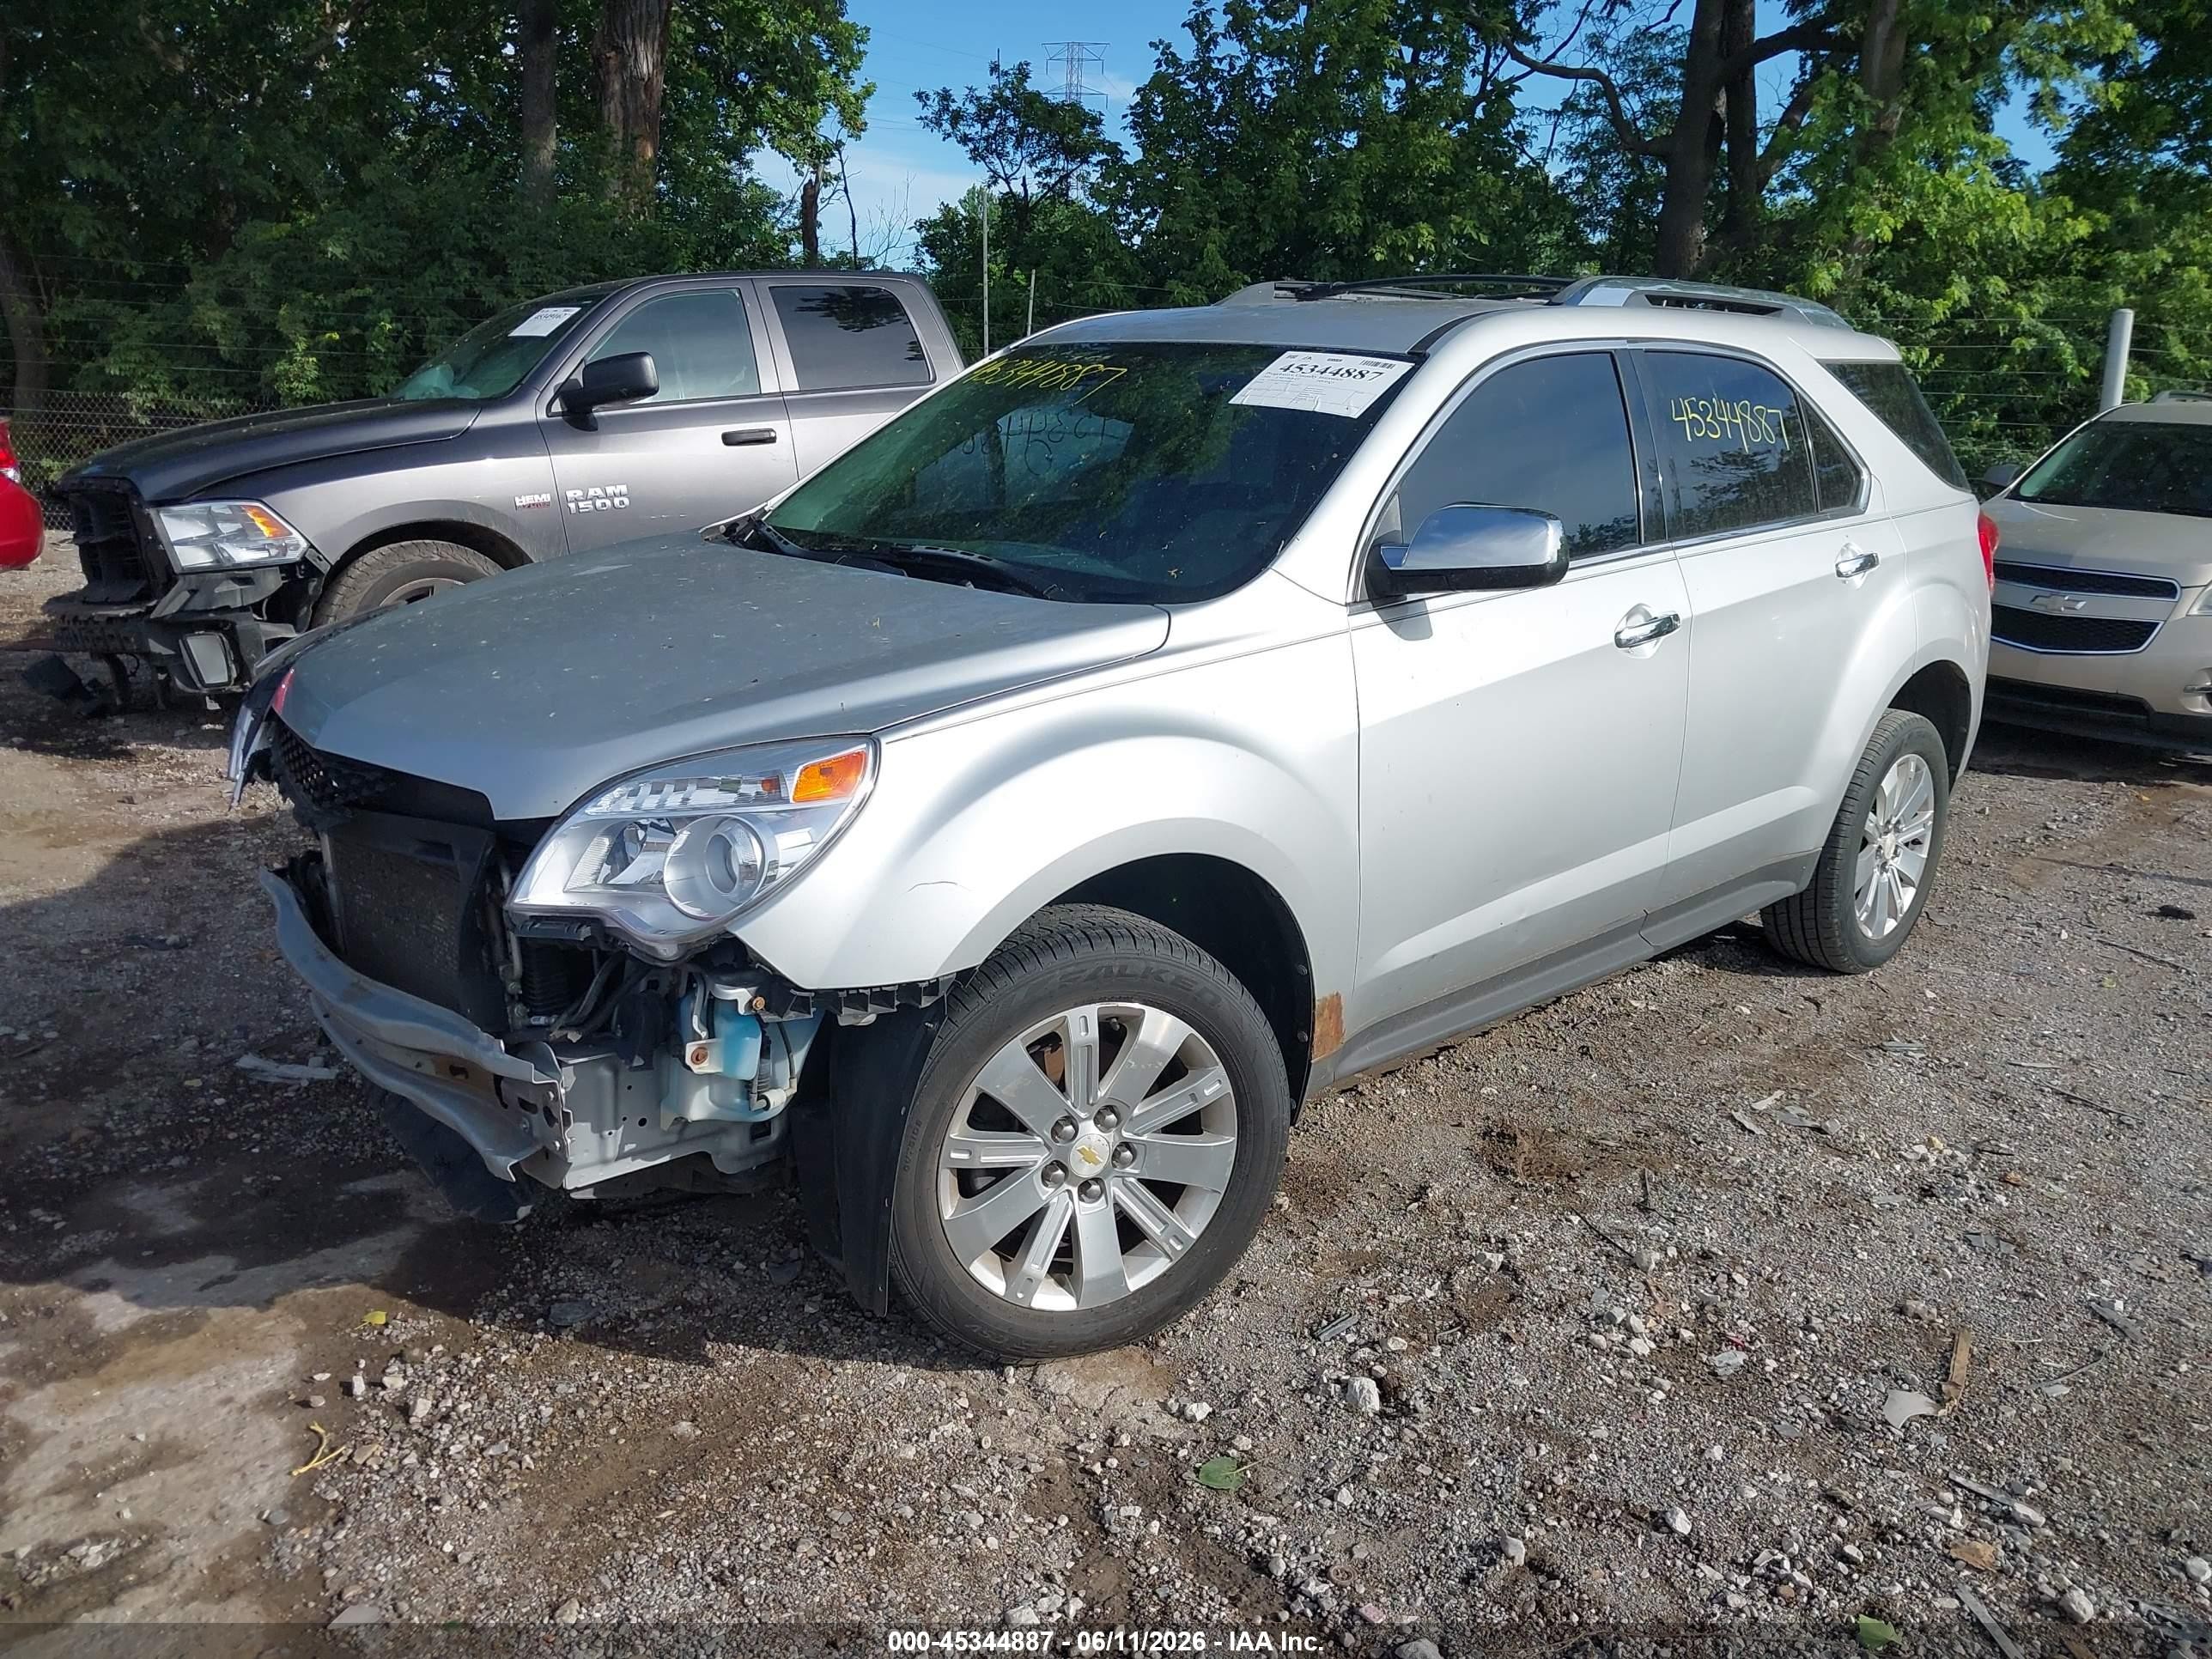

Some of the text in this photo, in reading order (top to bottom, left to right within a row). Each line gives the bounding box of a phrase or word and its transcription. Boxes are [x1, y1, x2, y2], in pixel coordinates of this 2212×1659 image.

[1279, 362, 1386, 383] 45344887
[1670, 397, 1790, 454] 45344887
[514, 493, 551, 507] HEMI
[565, 484, 628, 502] RAM
[567, 496, 630, 514] 1500
